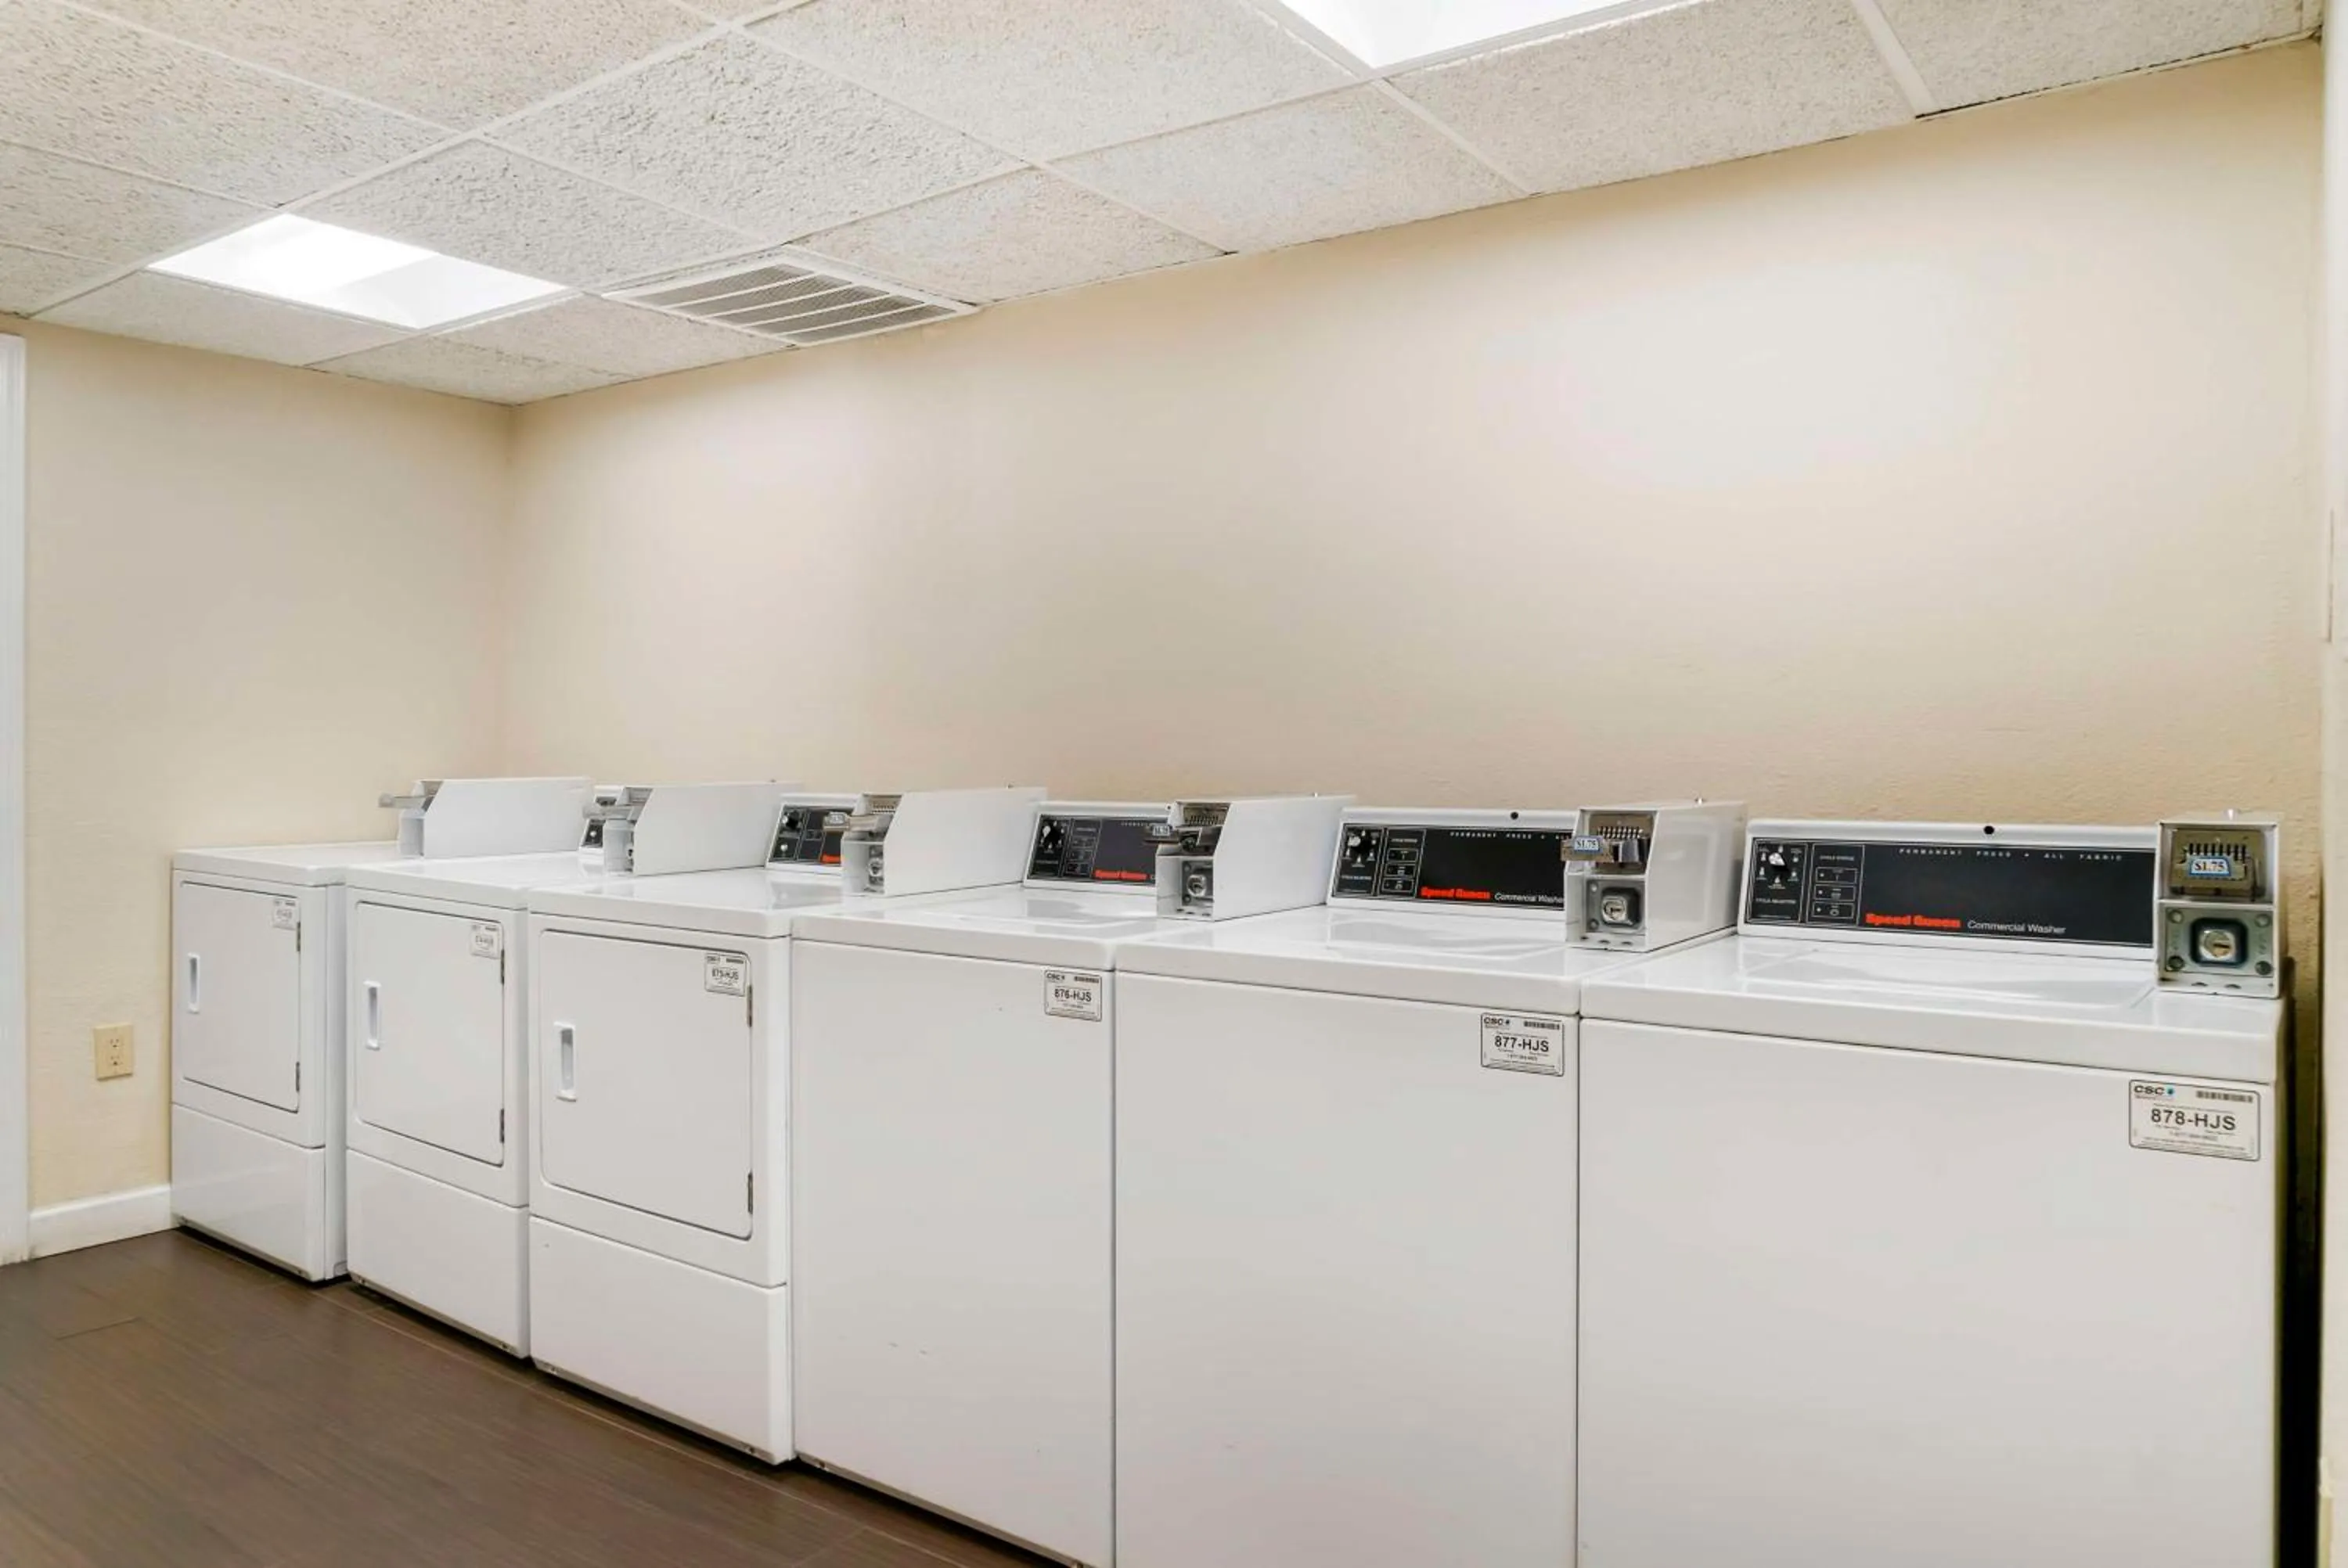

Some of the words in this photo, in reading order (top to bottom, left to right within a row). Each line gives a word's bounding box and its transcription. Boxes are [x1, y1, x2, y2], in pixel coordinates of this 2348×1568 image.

[2194, 863, 2225, 872] $1.75
[1866, 912, 1911, 926] Speed
[1914, 914, 1961, 928] Queen
[1967, 919, 2026, 933] Commercial
[2028, 922, 2066, 934] Washer
[1054, 988, 1092, 1002] 876-HJS
[1494, 1035, 1549, 1052] 877-HJS
[2134, 1085, 2165, 1095] CSC
[2151, 1108, 2236, 1131] 878-HJS
